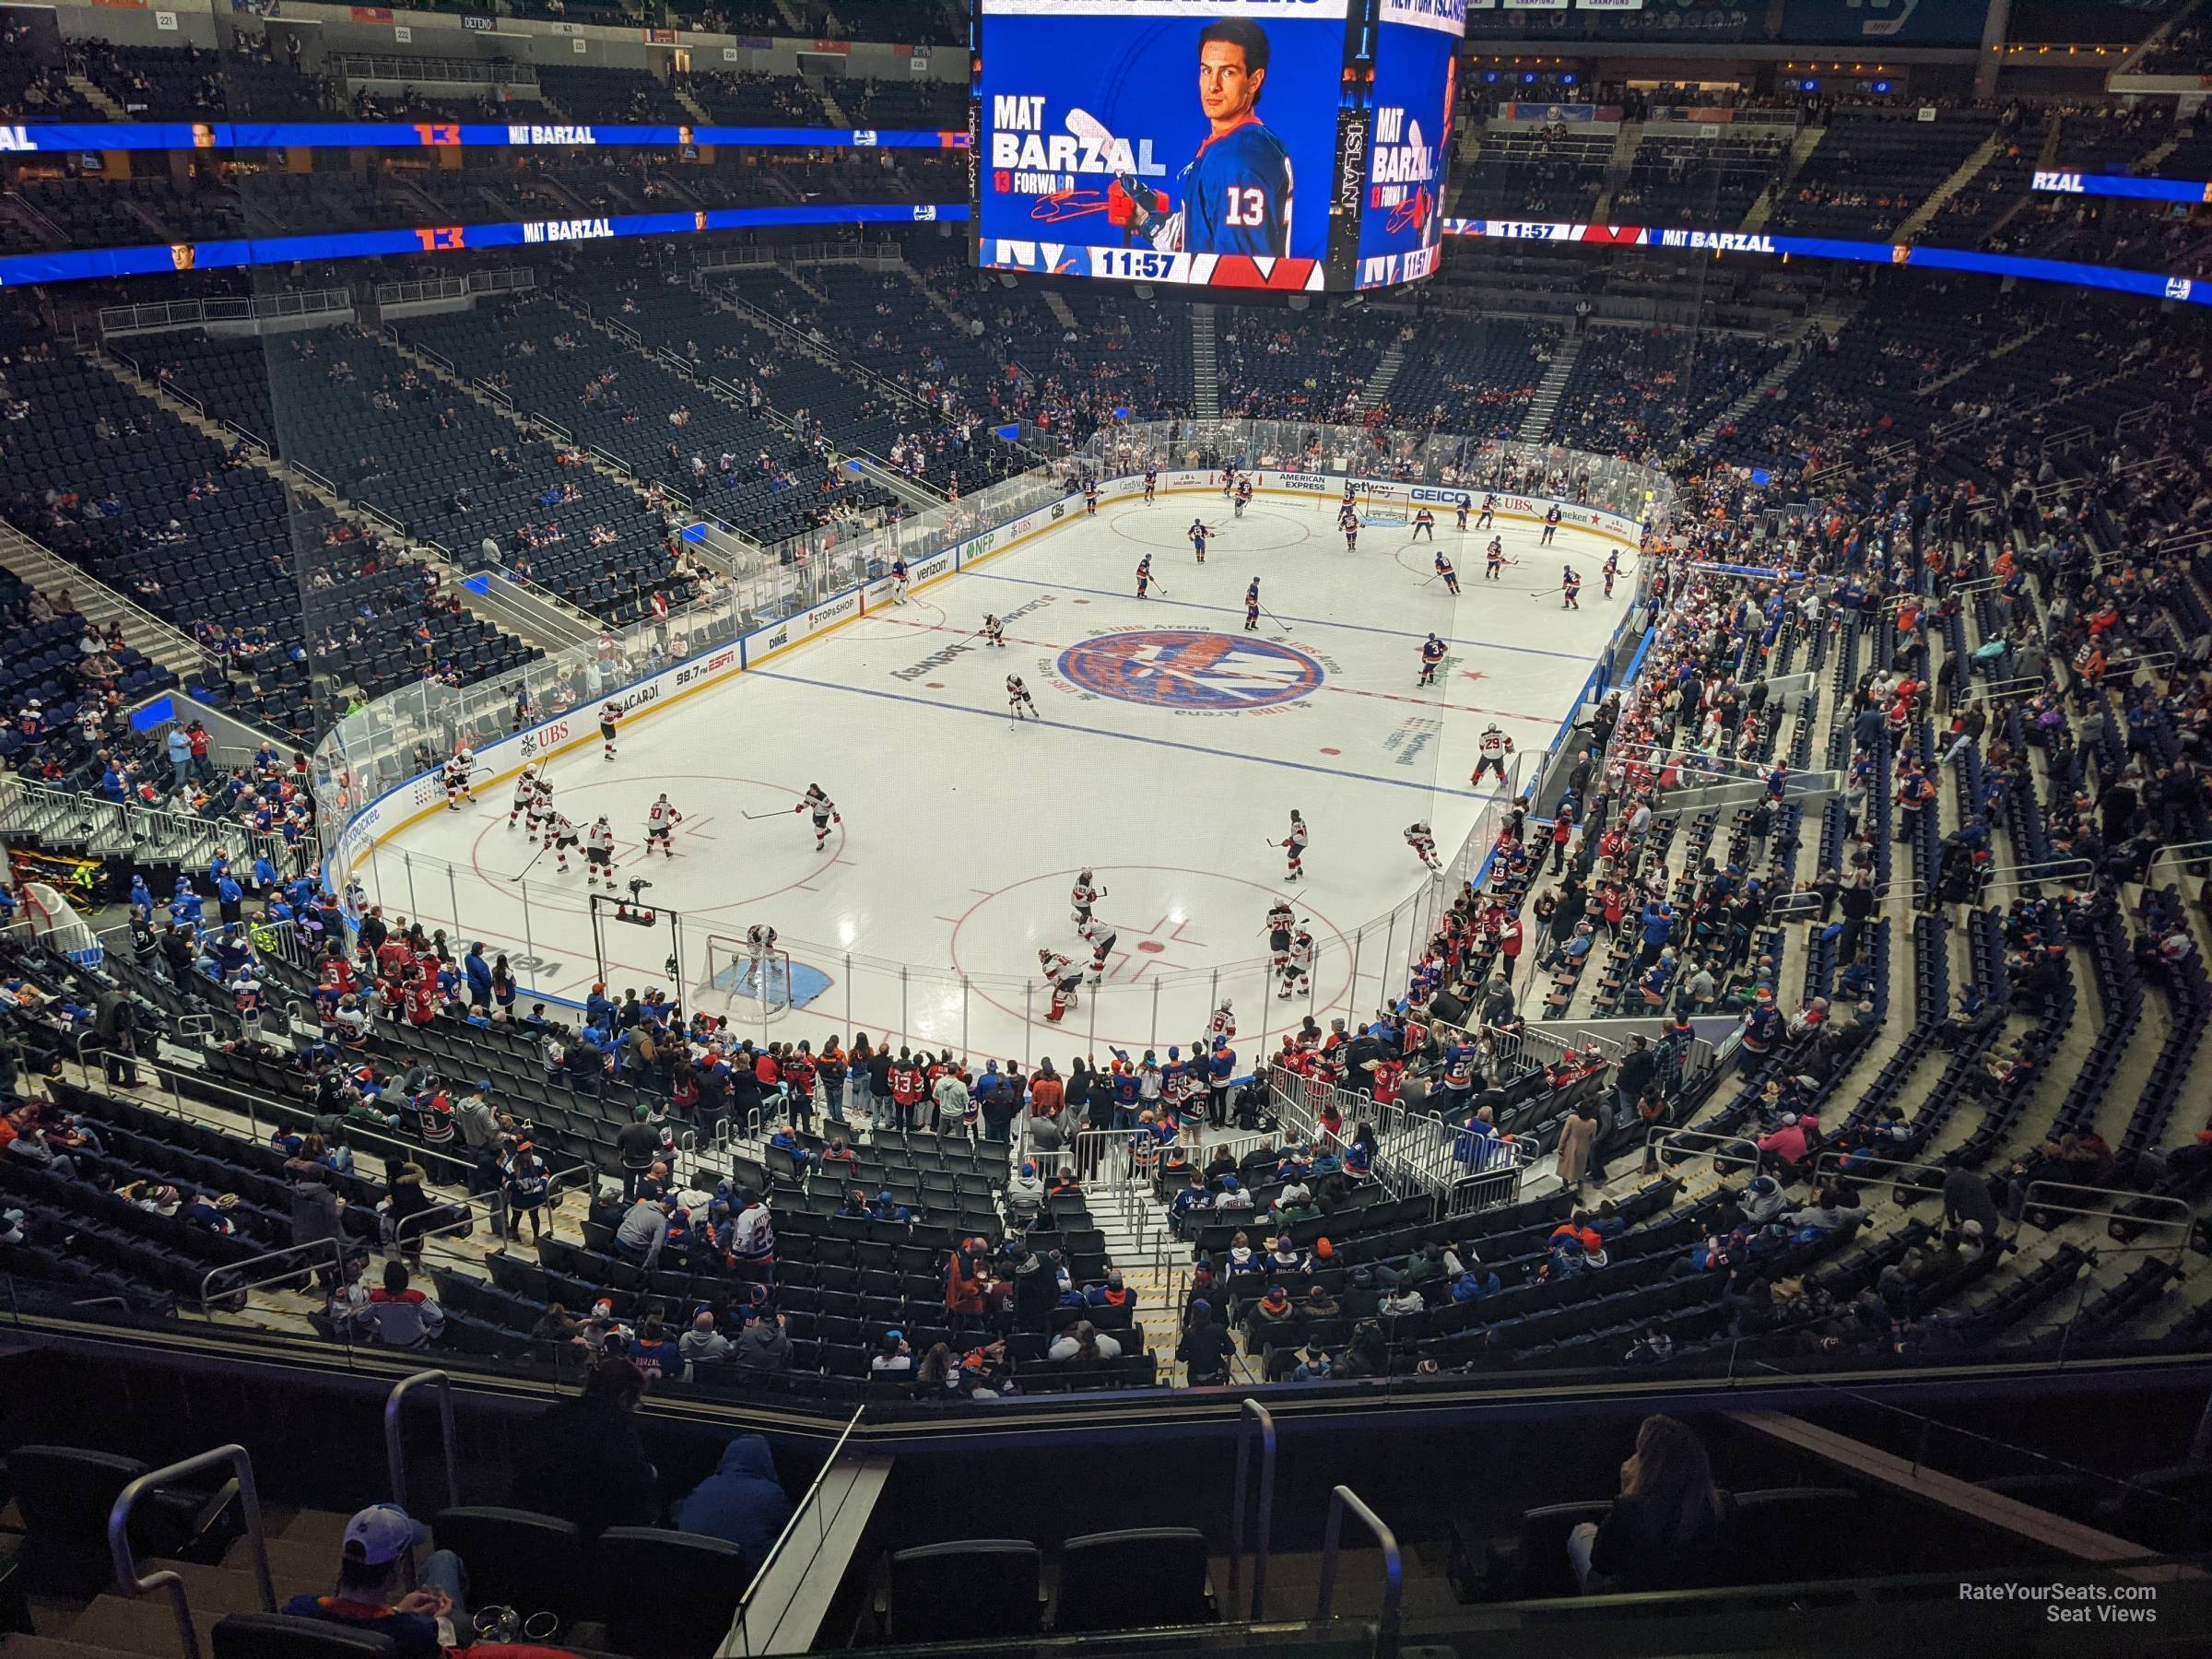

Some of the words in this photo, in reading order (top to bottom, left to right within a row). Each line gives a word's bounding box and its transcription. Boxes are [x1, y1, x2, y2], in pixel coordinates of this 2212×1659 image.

[159, 17, 173, 26] 221
[465, 18, 492, 29] DEFEND
[397, 30, 408, 39] 222
[994, 95, 1045, 131] MAT
[1376, 108, 1404, 143] MAT
[413, 124, 463, 146] 13
[509, 125, 529, 145] MAT
[532, 125, 596, 145] BARZAL
[993, 133, 1166, 176] BARZAL
[1371, 147, 1433, 183] BARZAL
[994, 171, 1010, 193] 13
[1015, 172, 1075, 194] FORWARD
[2032, 171, 2085, 192] RZAL
[1371, 186, 1381, 208] 13
[1226, 187, 1265, 226] 13
[416, 227, 465, 251] 13
[524, 222, 545, 243] MAT
[547, 218, 614, 241] BARZAL
[1500, 223, 1555, 240] 11:57
[1663, 229, 1688, 246] MAT
[1690, 231, 1775, 253] BARZAL
[1103, 251, 1176, 278] 11:57
[1406, 251, 1426, 279] 11:57
[1279, 473, 1325, 484] AMERICAN
[1285, 482, 1325, 491] EXPRESS
[1411, 488, 1469, 504] GEICO
[1504, 498, 1531, 511] UBS
[1018, 519, 1031, 534] UBS
[975, 533, 994, 556] NFP
[917, 559, 947, 581] verizon
[814, 599, 854, 624] STOP&SHOP
[1154, 623, 1210, 631] Arena
[769, 632, 788, 650] DIME
[1431, 645, 1439, 653] 3
[677, 665, 700, 686] 98.7
[709, 651, 735, 672] ESPN
[889, 644, 977, 682] betway
[22, 721, 36, 735] 27
[538, 721, 569, 748] UBS
[1486, 738, 1500, 749] 29
[269, 804, 279, 813] 17
[1493, 867, 1504, 877] 13
[1273, 920, 1289, 931] 20
[236, 995, 256, 1011] 27
[895, 1076, 912, 1092] 13
[332, 1088, 344, 1099] 27
[965, 1100, 977, 1112] 13
[1191, 1100, 1205, 1115] 16
[418, 1112, 437, 1130] 13
